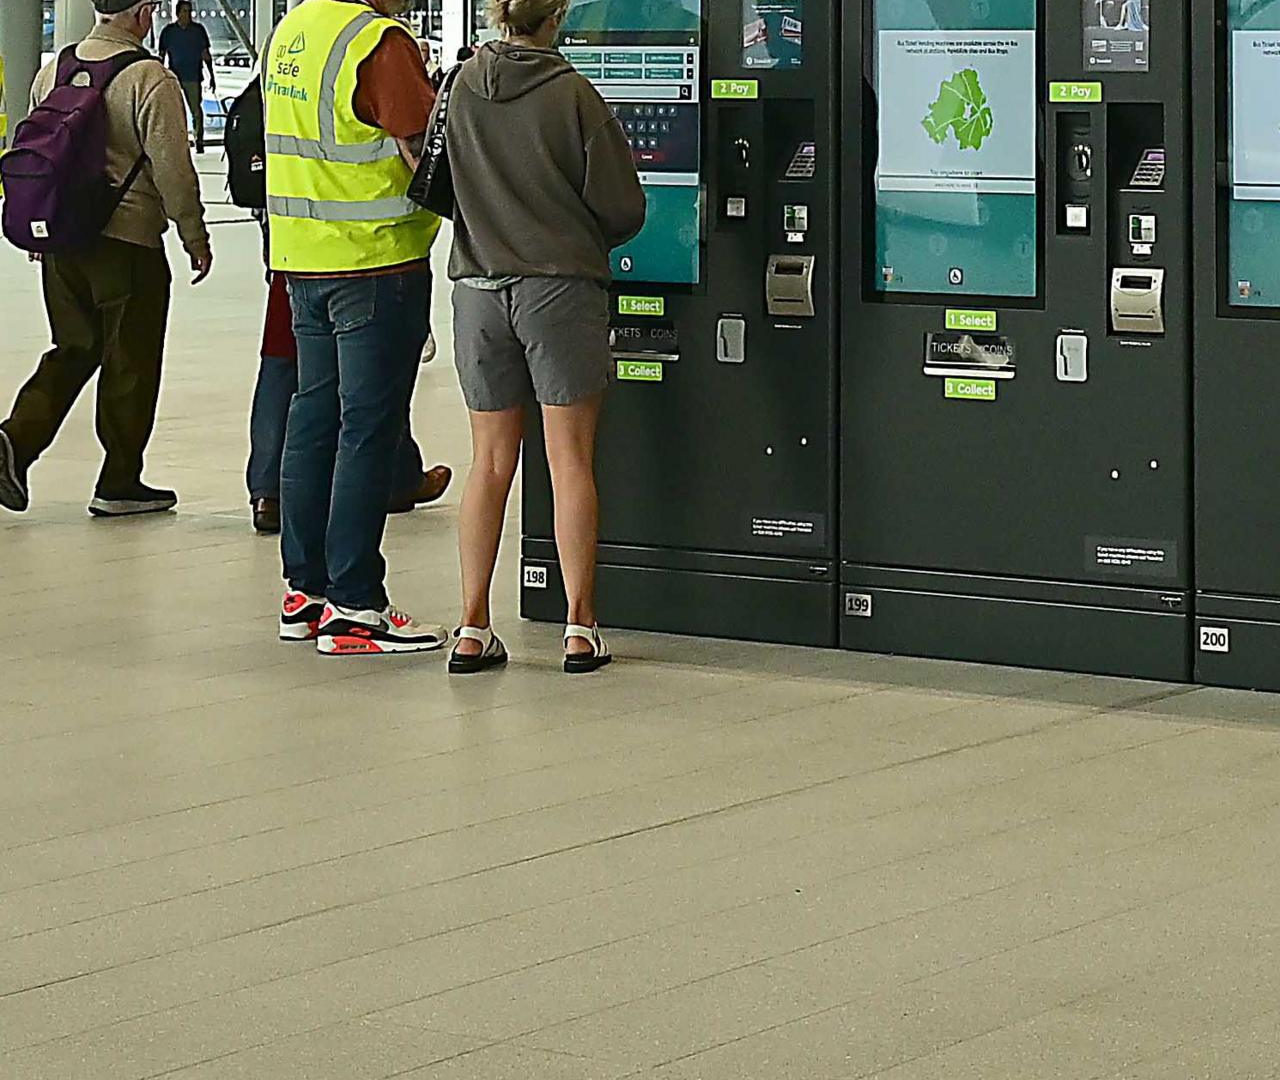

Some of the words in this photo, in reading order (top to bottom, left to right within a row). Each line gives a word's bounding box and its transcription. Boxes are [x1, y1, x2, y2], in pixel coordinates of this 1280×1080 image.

[1060, 86, 1066, 97] 2
[1070, 86, 1090, 98] Pay
[950, 313, 956, 325] 1
[960, 315, 992, 326] Select
[932, 342, 971, 353] TICKETS
[947, 383, 953, 394] 3
[958, 383, 993, 396] Collect
[526, 570, 545, 584] 198
[847, 595, 869, 612] 199
[1202, 631, 1226, 647] 200
